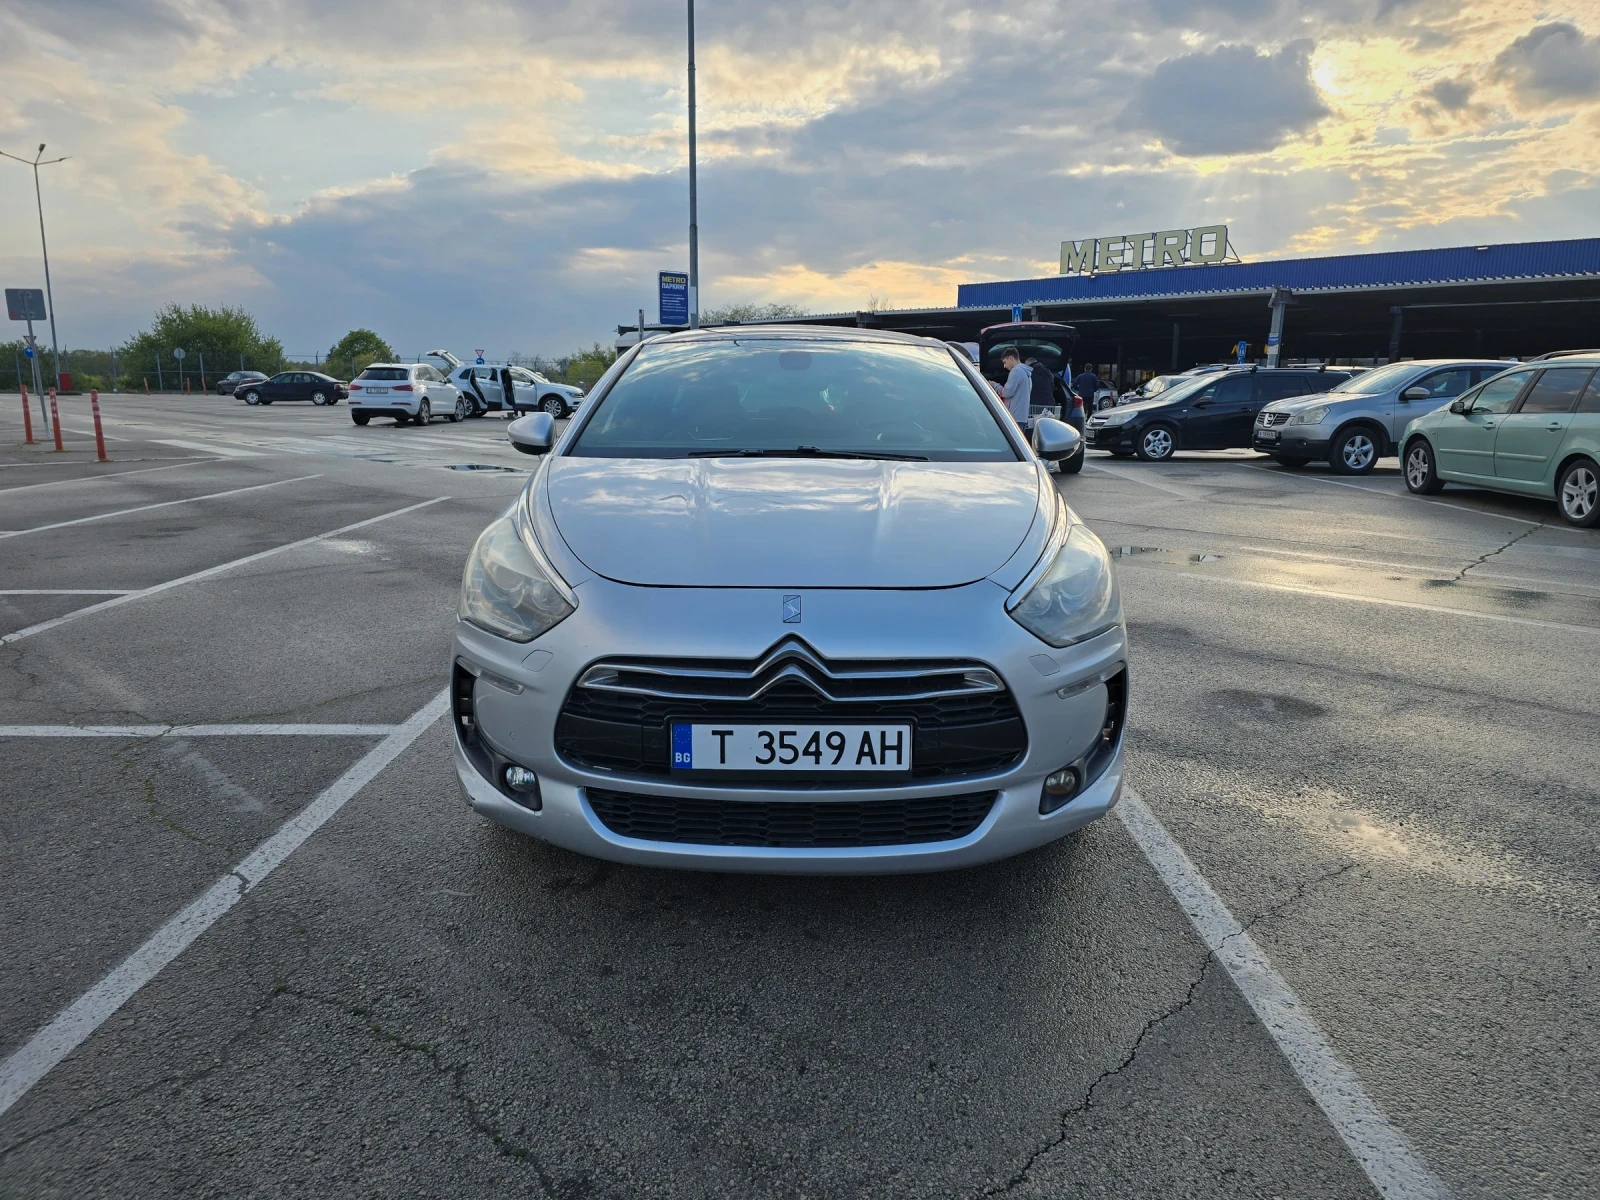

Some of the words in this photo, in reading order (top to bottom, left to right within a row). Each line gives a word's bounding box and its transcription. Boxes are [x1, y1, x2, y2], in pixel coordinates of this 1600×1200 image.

[1059, 225, 1227, 274] METRO
[675, 752, 691, 763] BG
[711, 730, 734, 764] T
[755, 730, 846, 765] 3549
[855, 730, 903, 765] AH
